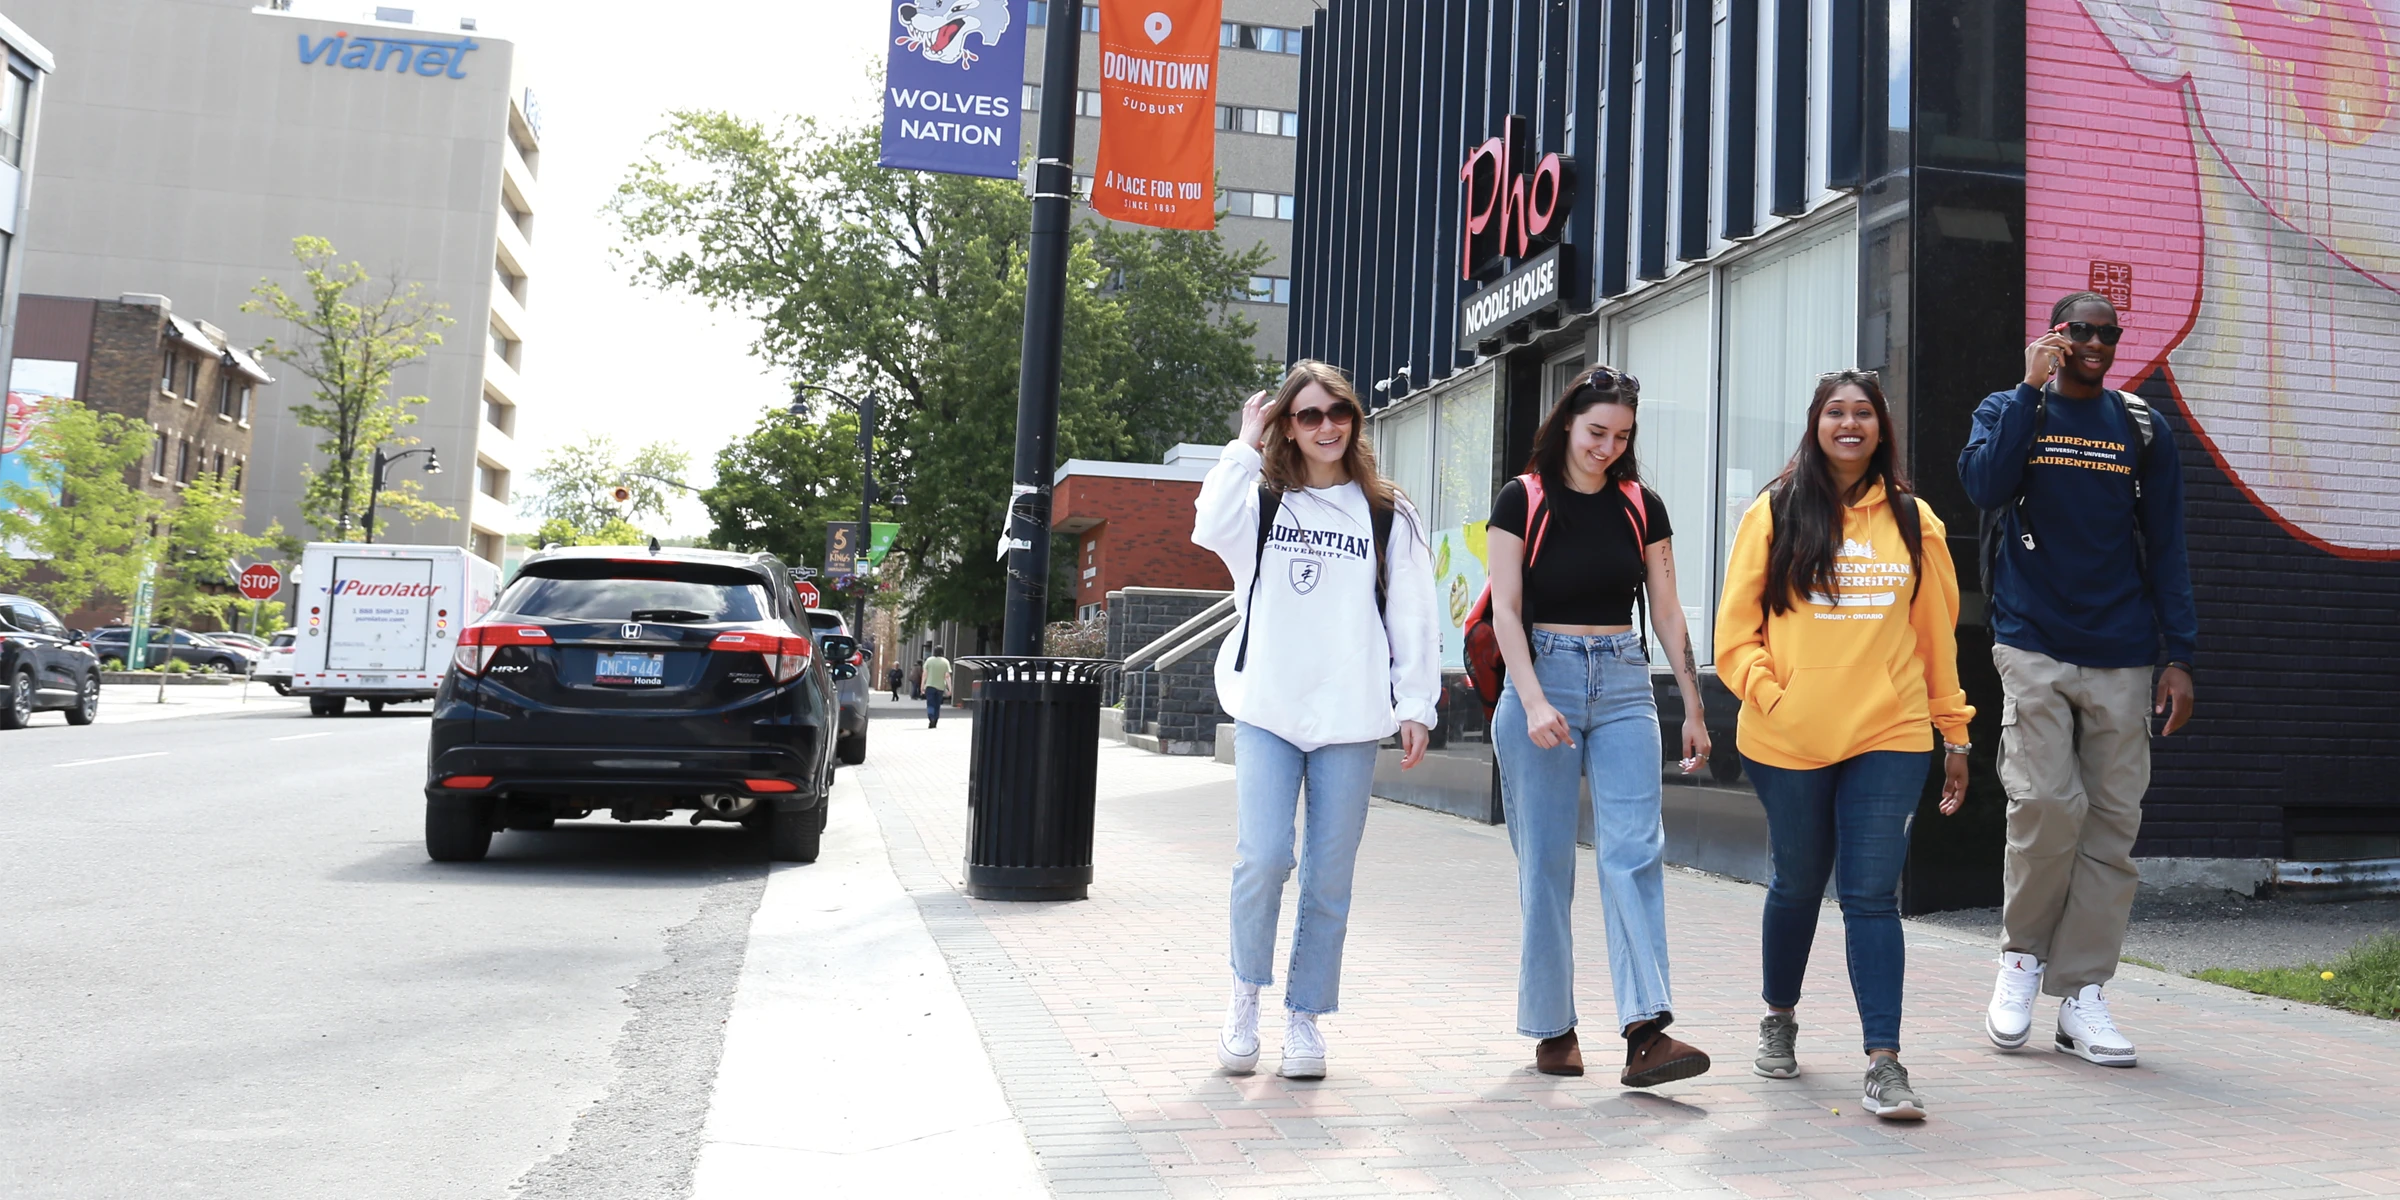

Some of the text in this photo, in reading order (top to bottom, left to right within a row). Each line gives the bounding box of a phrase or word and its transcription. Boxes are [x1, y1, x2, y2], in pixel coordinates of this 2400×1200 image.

[297, 30, 480, 79] vianet
[1103, 51, 1210, 90] DOWNTOWN
[890, 87, 1010, 117] WOLVES
[1122, 96, 1184, 115] SUDBURY
[900, 118, 1002, 147] NATION
[1104, 170, 1202, 200] A PLACE FOR YOU
[1460, 113, 1561, 280] Pho
[1124, 199, 1176, 213] SINCE 1883
[1465, 258, 1554, 337] NOODLE HOUSE
[2037, 435, 2125, 452] LAURENTIAN
[2045, 447, 2117, 460] UNIVERSITY UNIVERSITÉ
[2028, 456, 2132, 475] LAURENTIENNE
[833, 528, 849, 550] 5
[1267, 524, 1370, 560] AURENTIAN
[829, 553, 850, 562] KINGS
[1274, 543, 1343, 558] UNIVERSITY
[242, 573, 279, 590] STOP
[342, 579, 442, 597] Purolator
[800, 592, 817, 606] OP
[1814, 612, 1846, 620] SUDBURY
[491, 665, 529, 673] HR-V
[634, 676, 662, 685] Honda
